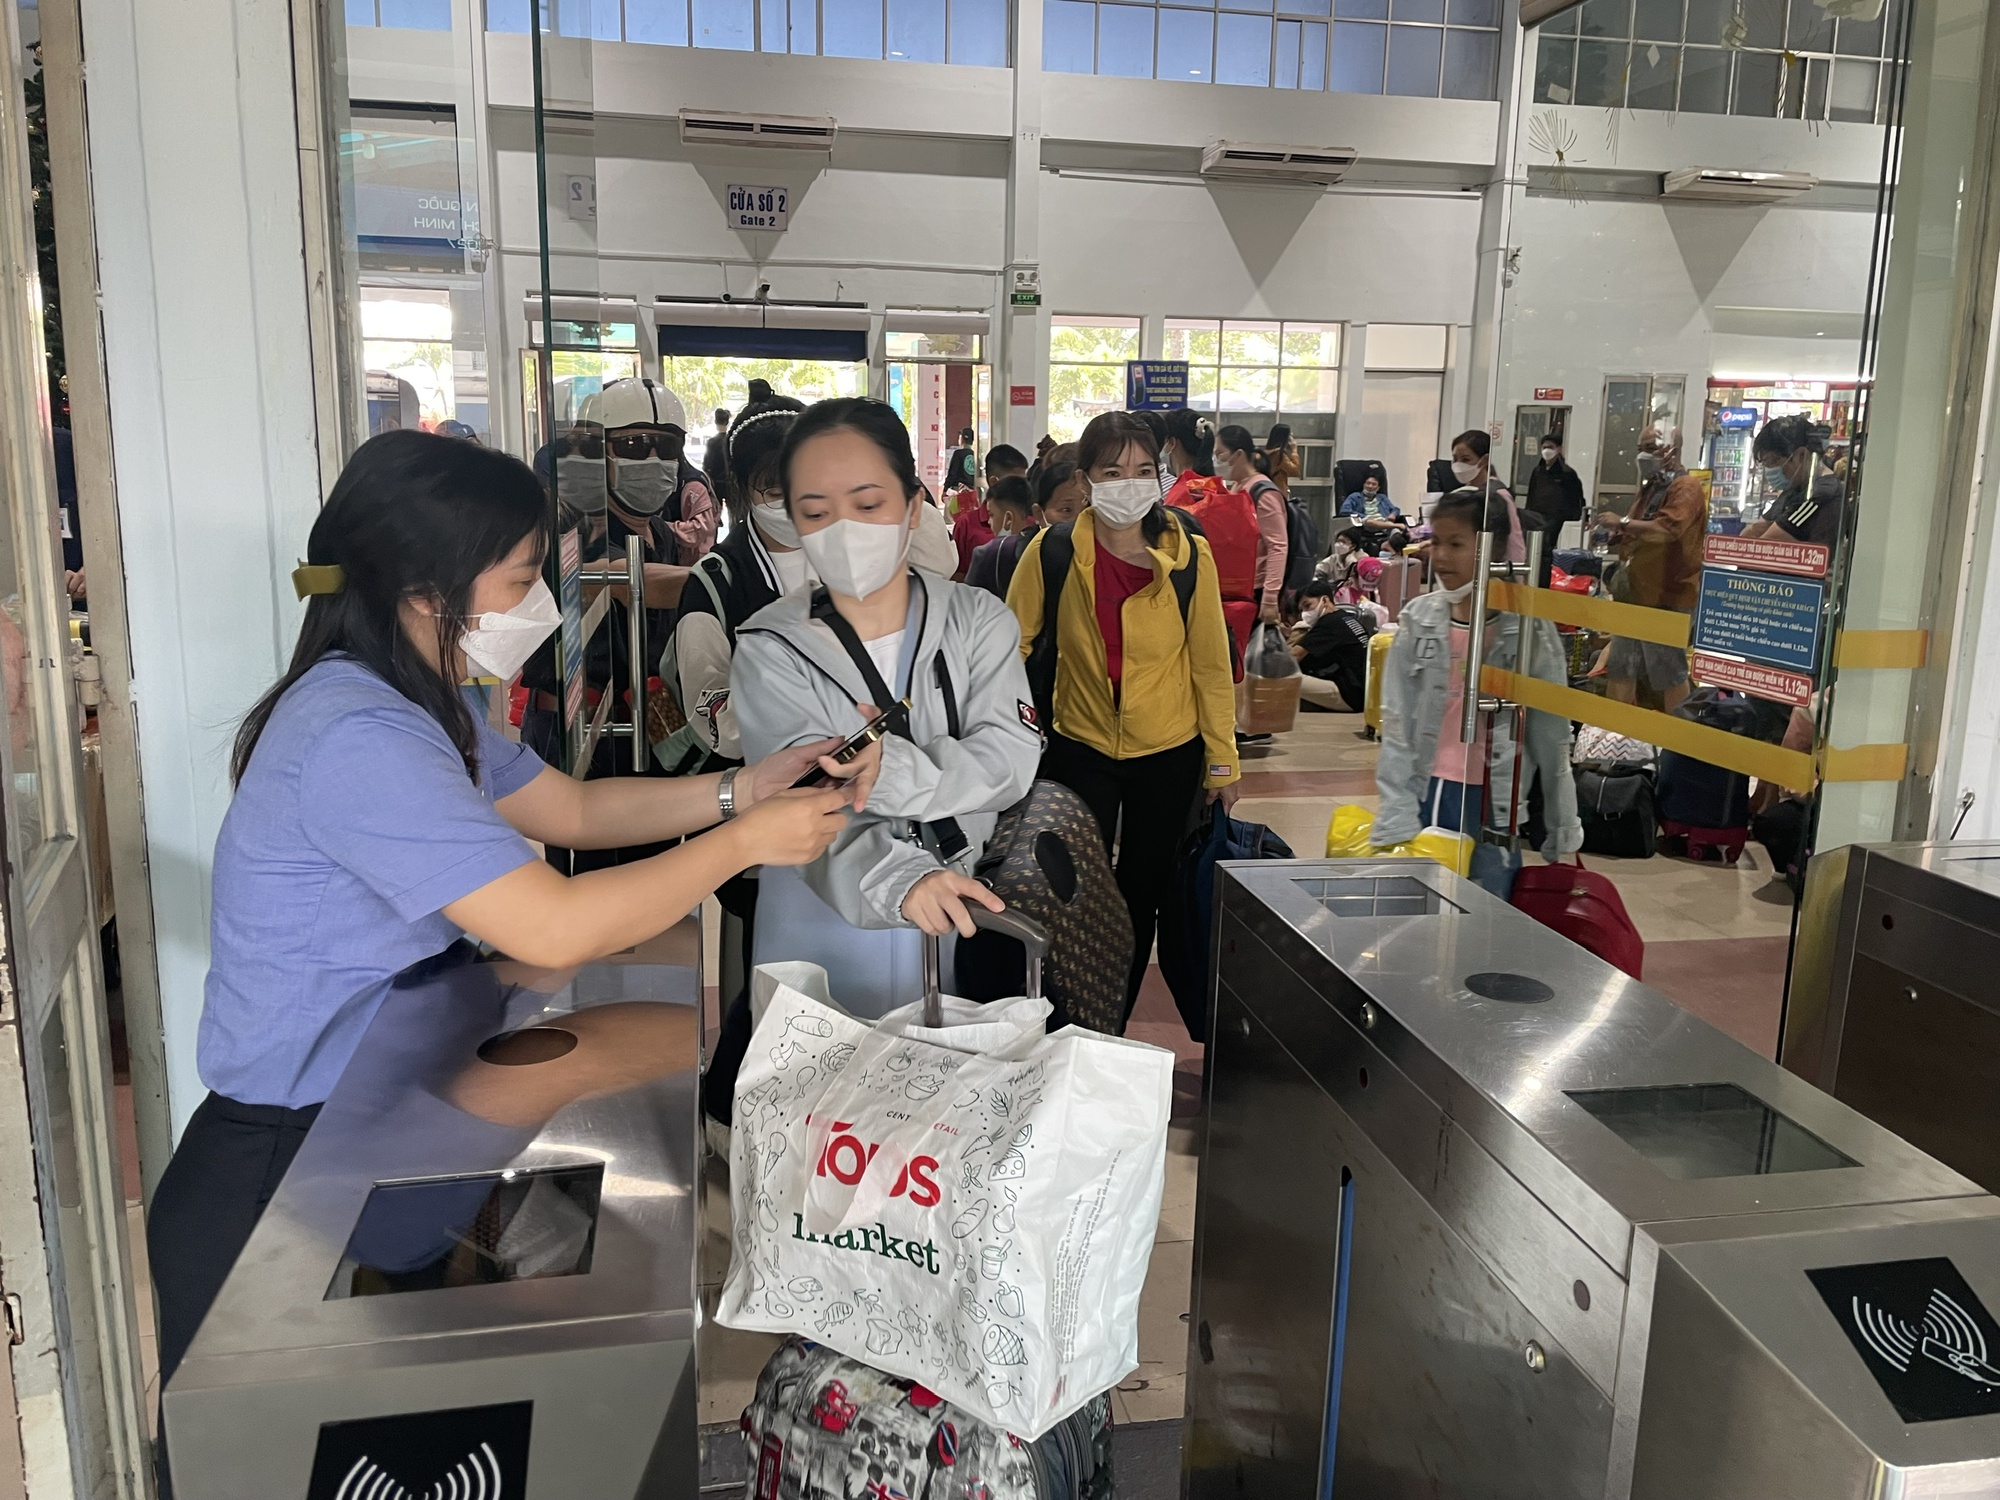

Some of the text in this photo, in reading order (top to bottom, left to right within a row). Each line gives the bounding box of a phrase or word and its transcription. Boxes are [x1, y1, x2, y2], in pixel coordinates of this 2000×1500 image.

[731, 187, 786, 212] CỬA SỐ 2
[741, 215, 776, 227] Gate 2
[1732, 413, 1752, 421] pepsi
[1800, 549, 1825, 565] 1.32m
[1726, 577, 1794, 597] THÔNG BÁO
[1784, 678, 1808, 697] 1.12m
[887, 1110, 959, 1136] CENT ETAIL
[805, 1113, 941, 1207] TOS
